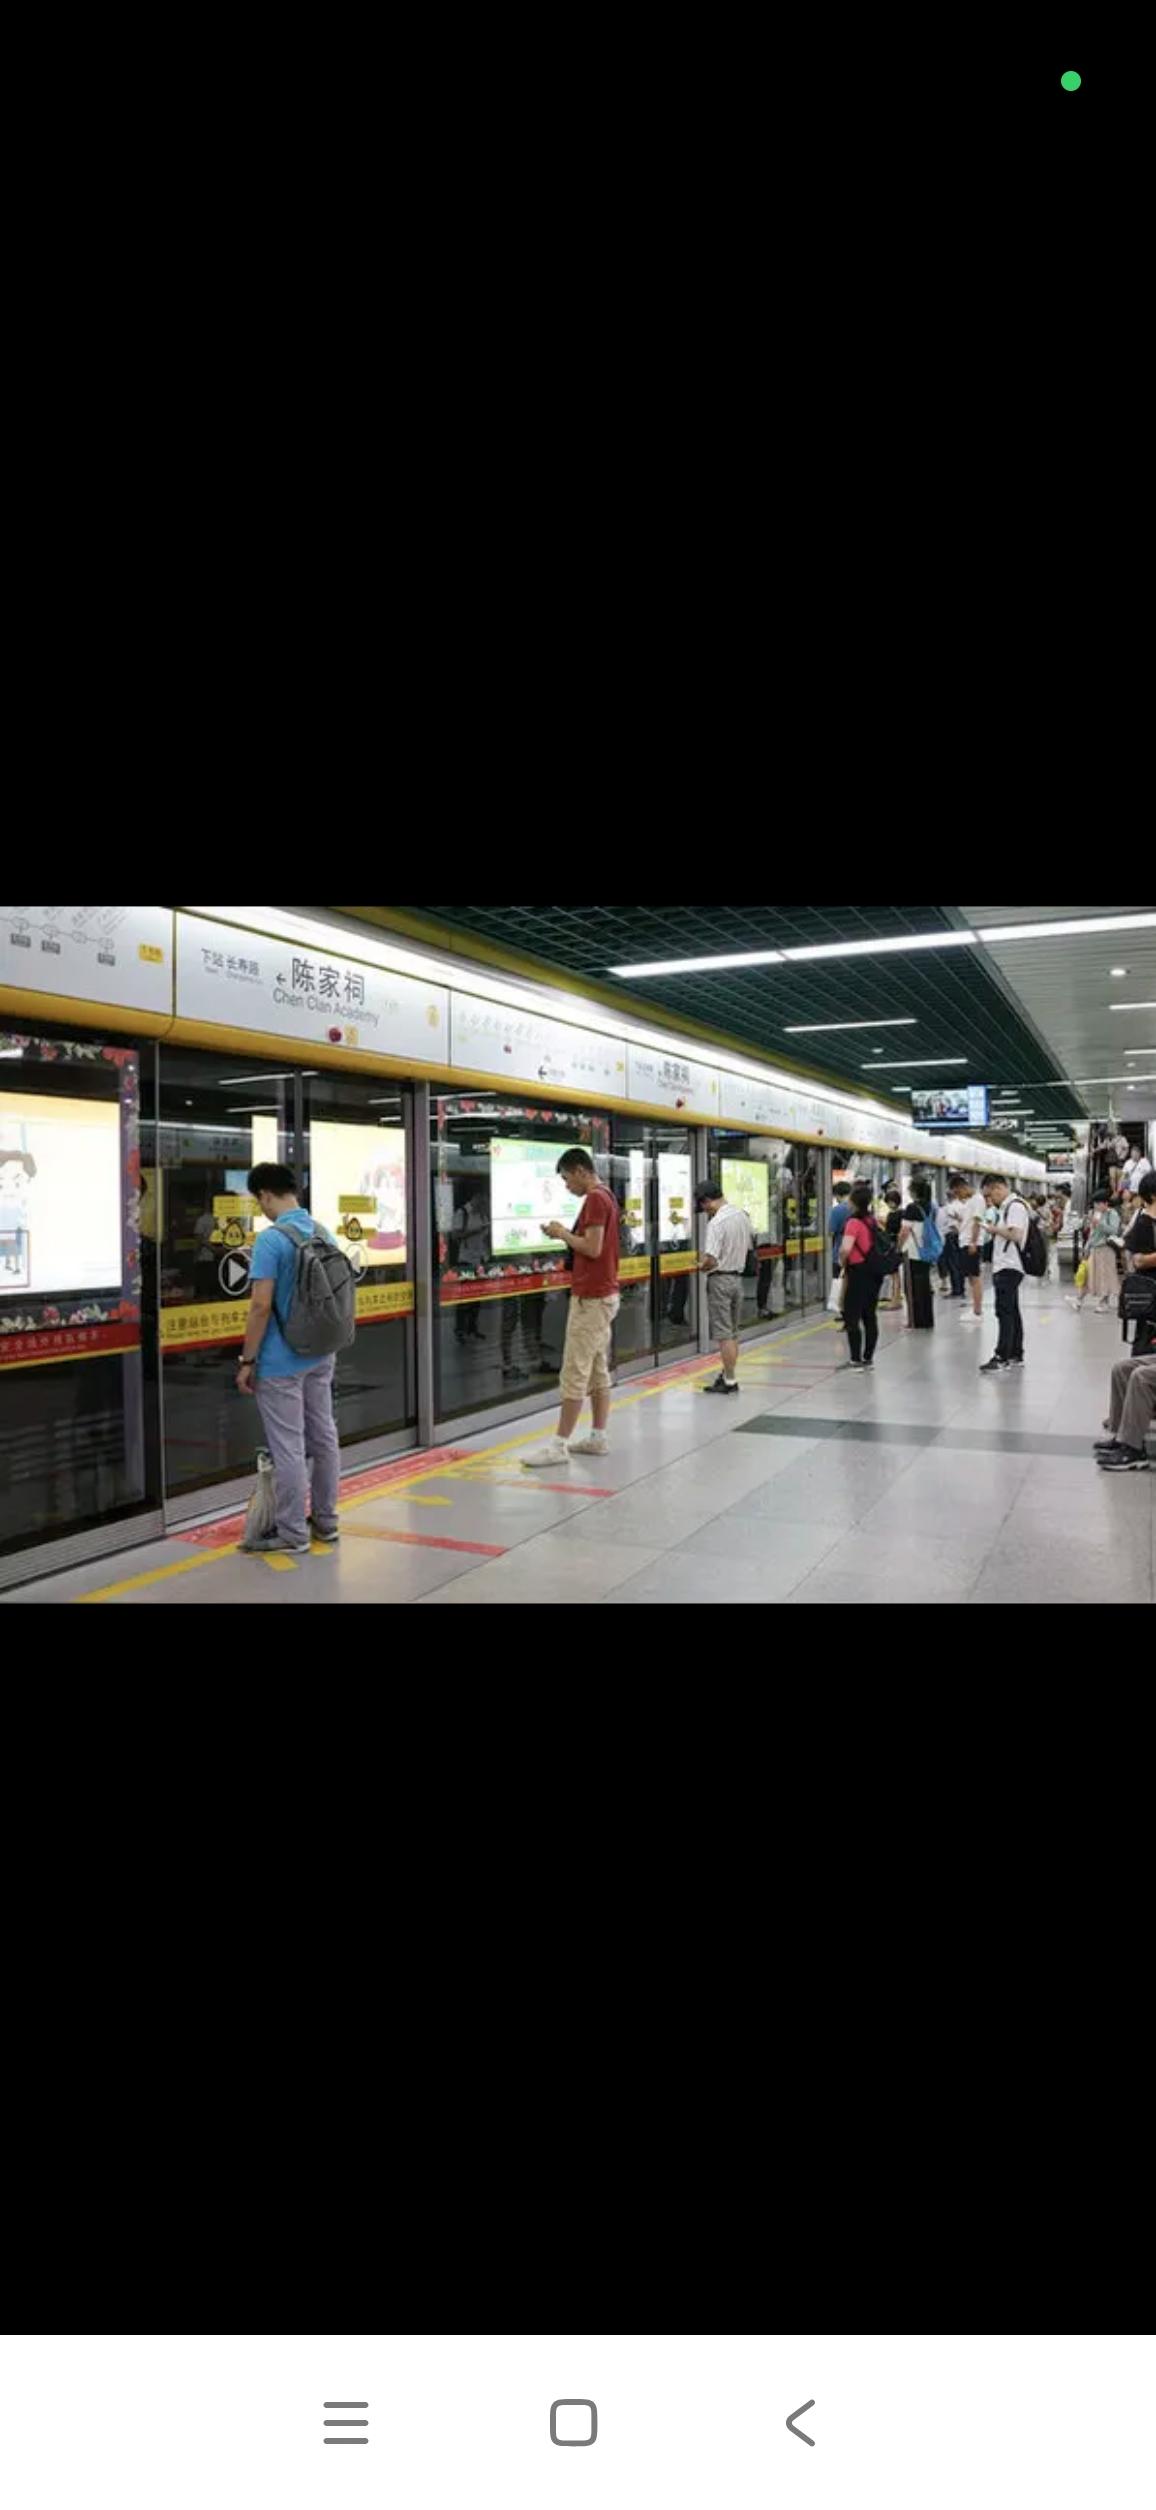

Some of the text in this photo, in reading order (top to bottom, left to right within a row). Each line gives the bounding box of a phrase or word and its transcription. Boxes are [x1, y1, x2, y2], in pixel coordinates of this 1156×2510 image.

[291, 957, 365, 1006] 陈家祠
[272, 986, 304, 1008] Chen
[306, 995, 332, 1014] Clan
[333, 1005, 381, 1028] Academy
